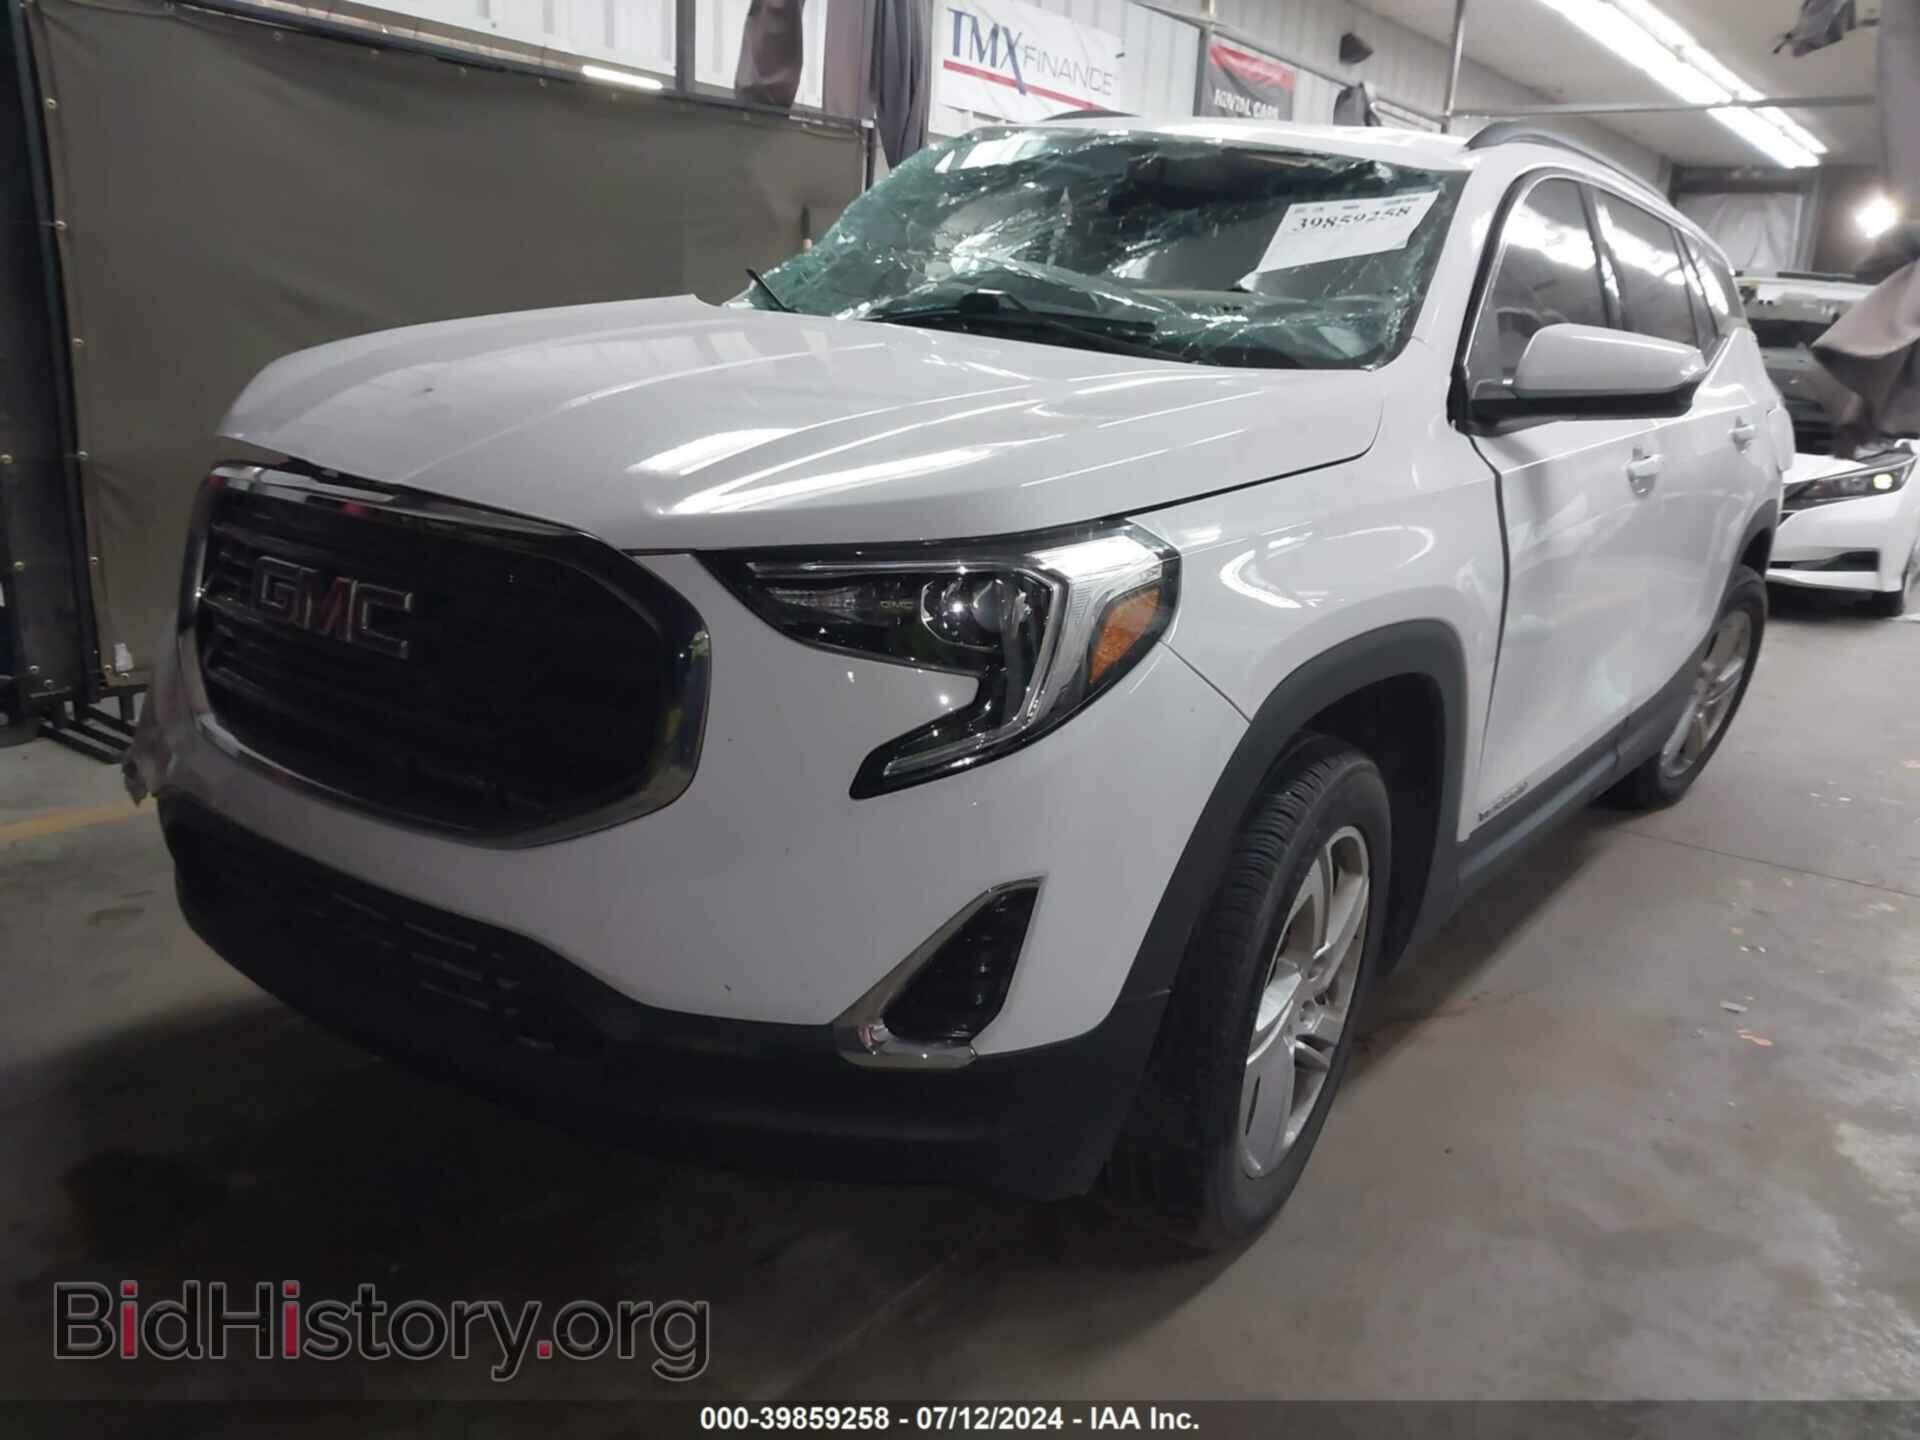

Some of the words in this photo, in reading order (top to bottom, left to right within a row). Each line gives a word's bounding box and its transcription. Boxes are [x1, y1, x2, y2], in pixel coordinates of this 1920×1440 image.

[946, 8, 1026, 95] TMX
[1022, 44, 1114, 96] FINANCE
[256, 555, 414, 660] GMC
